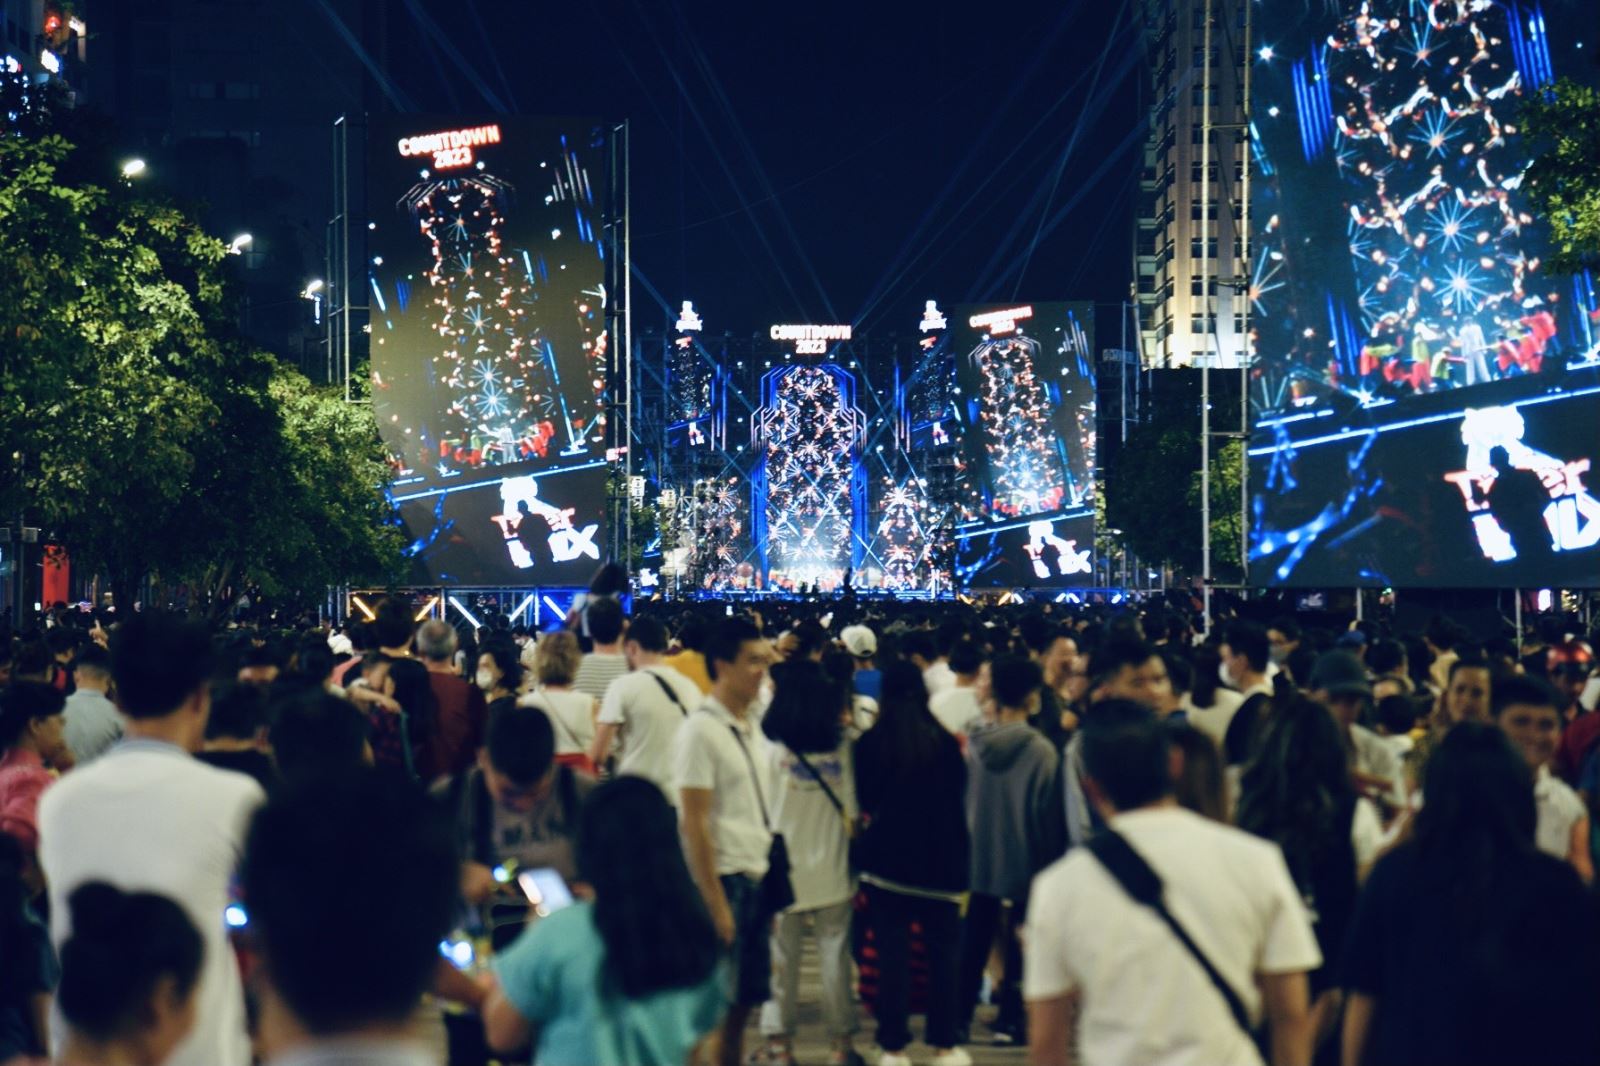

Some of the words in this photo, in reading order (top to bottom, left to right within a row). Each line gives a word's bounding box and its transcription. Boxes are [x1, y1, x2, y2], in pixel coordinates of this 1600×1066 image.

[398, 125, 500, 156] COUNTDOWN
[432, 147, 472, 169] 2023
[770, 324, 852, 340] COUNTDOWN
[795, 339, 827, 354] 2023
